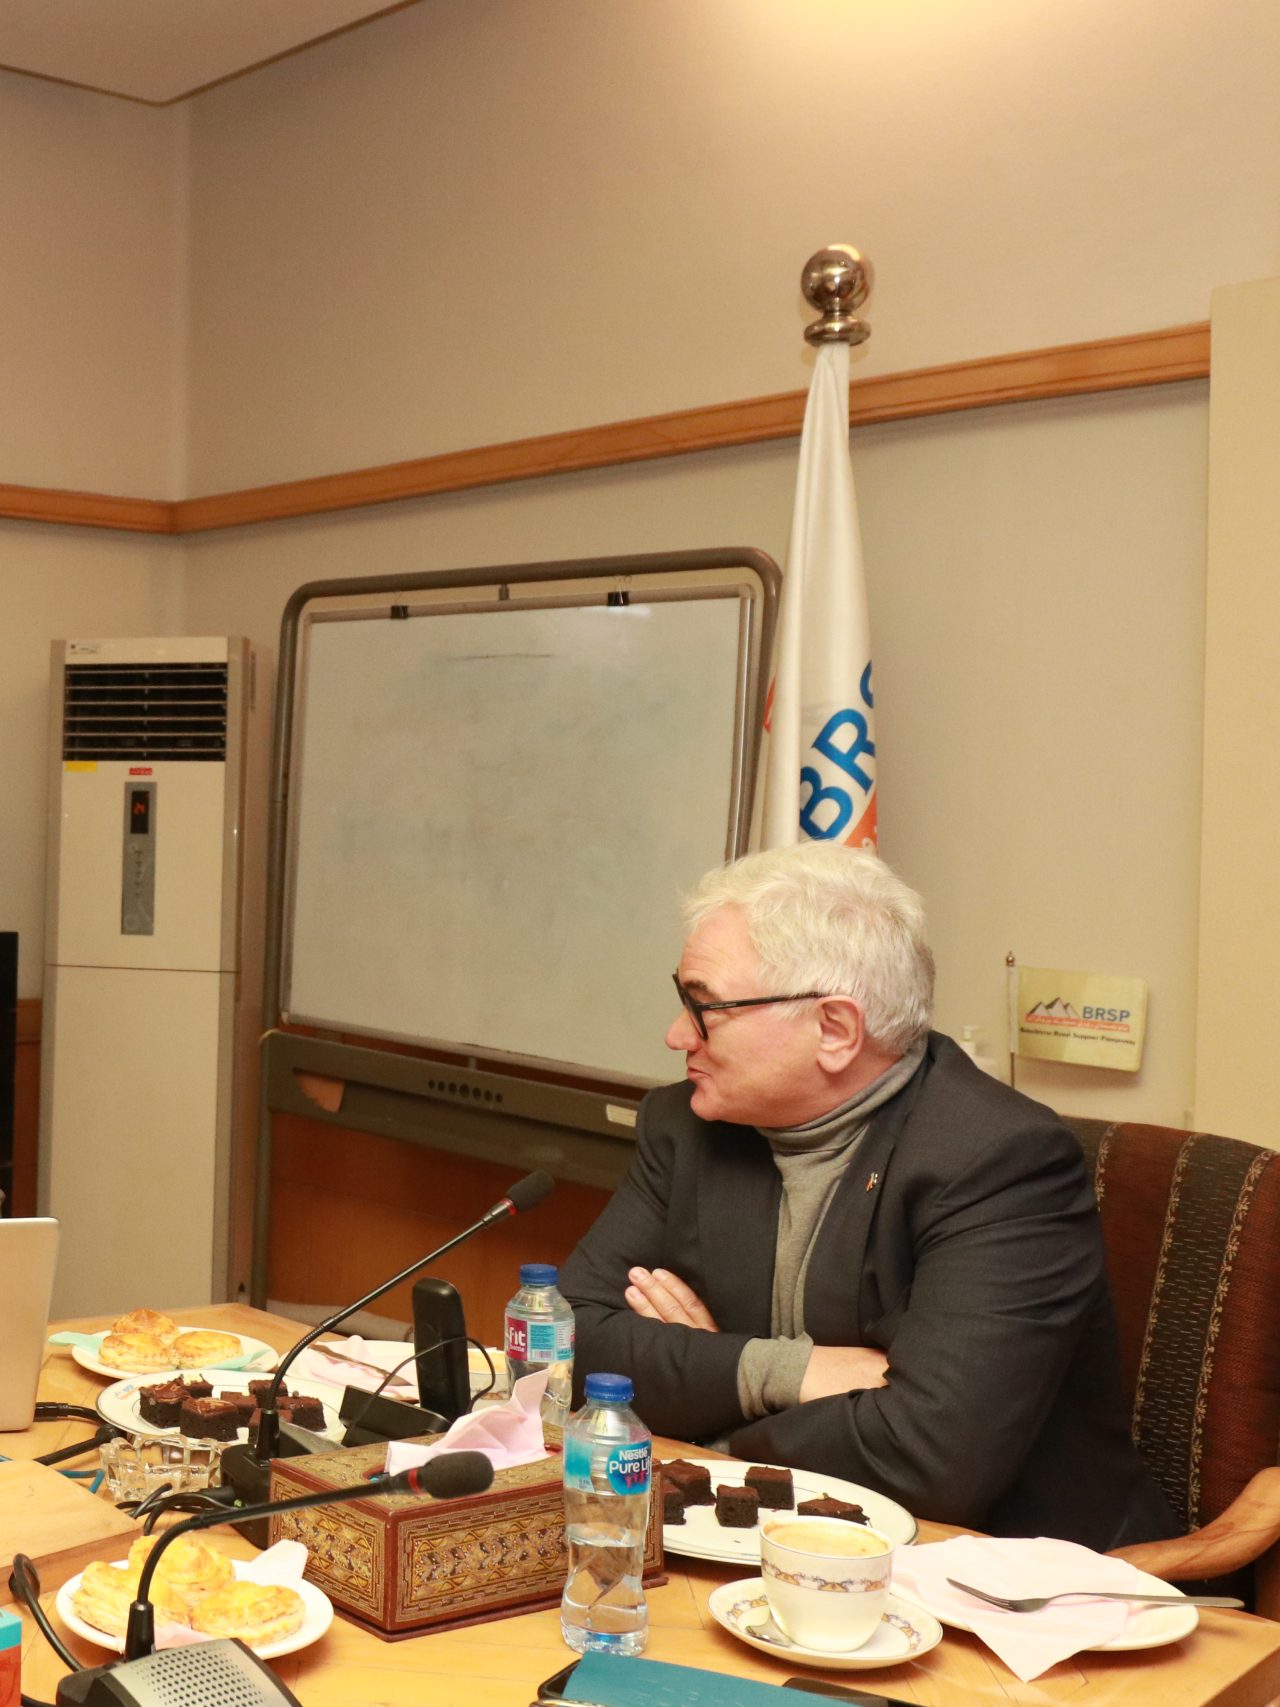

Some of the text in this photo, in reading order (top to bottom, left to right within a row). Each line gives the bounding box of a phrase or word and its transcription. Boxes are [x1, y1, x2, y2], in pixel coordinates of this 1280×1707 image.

[1083, 1006, 1130, 1022] BRSP
[509, 1326, 526, 1346] fit
[609, 1461, 640, 1474] Pure
